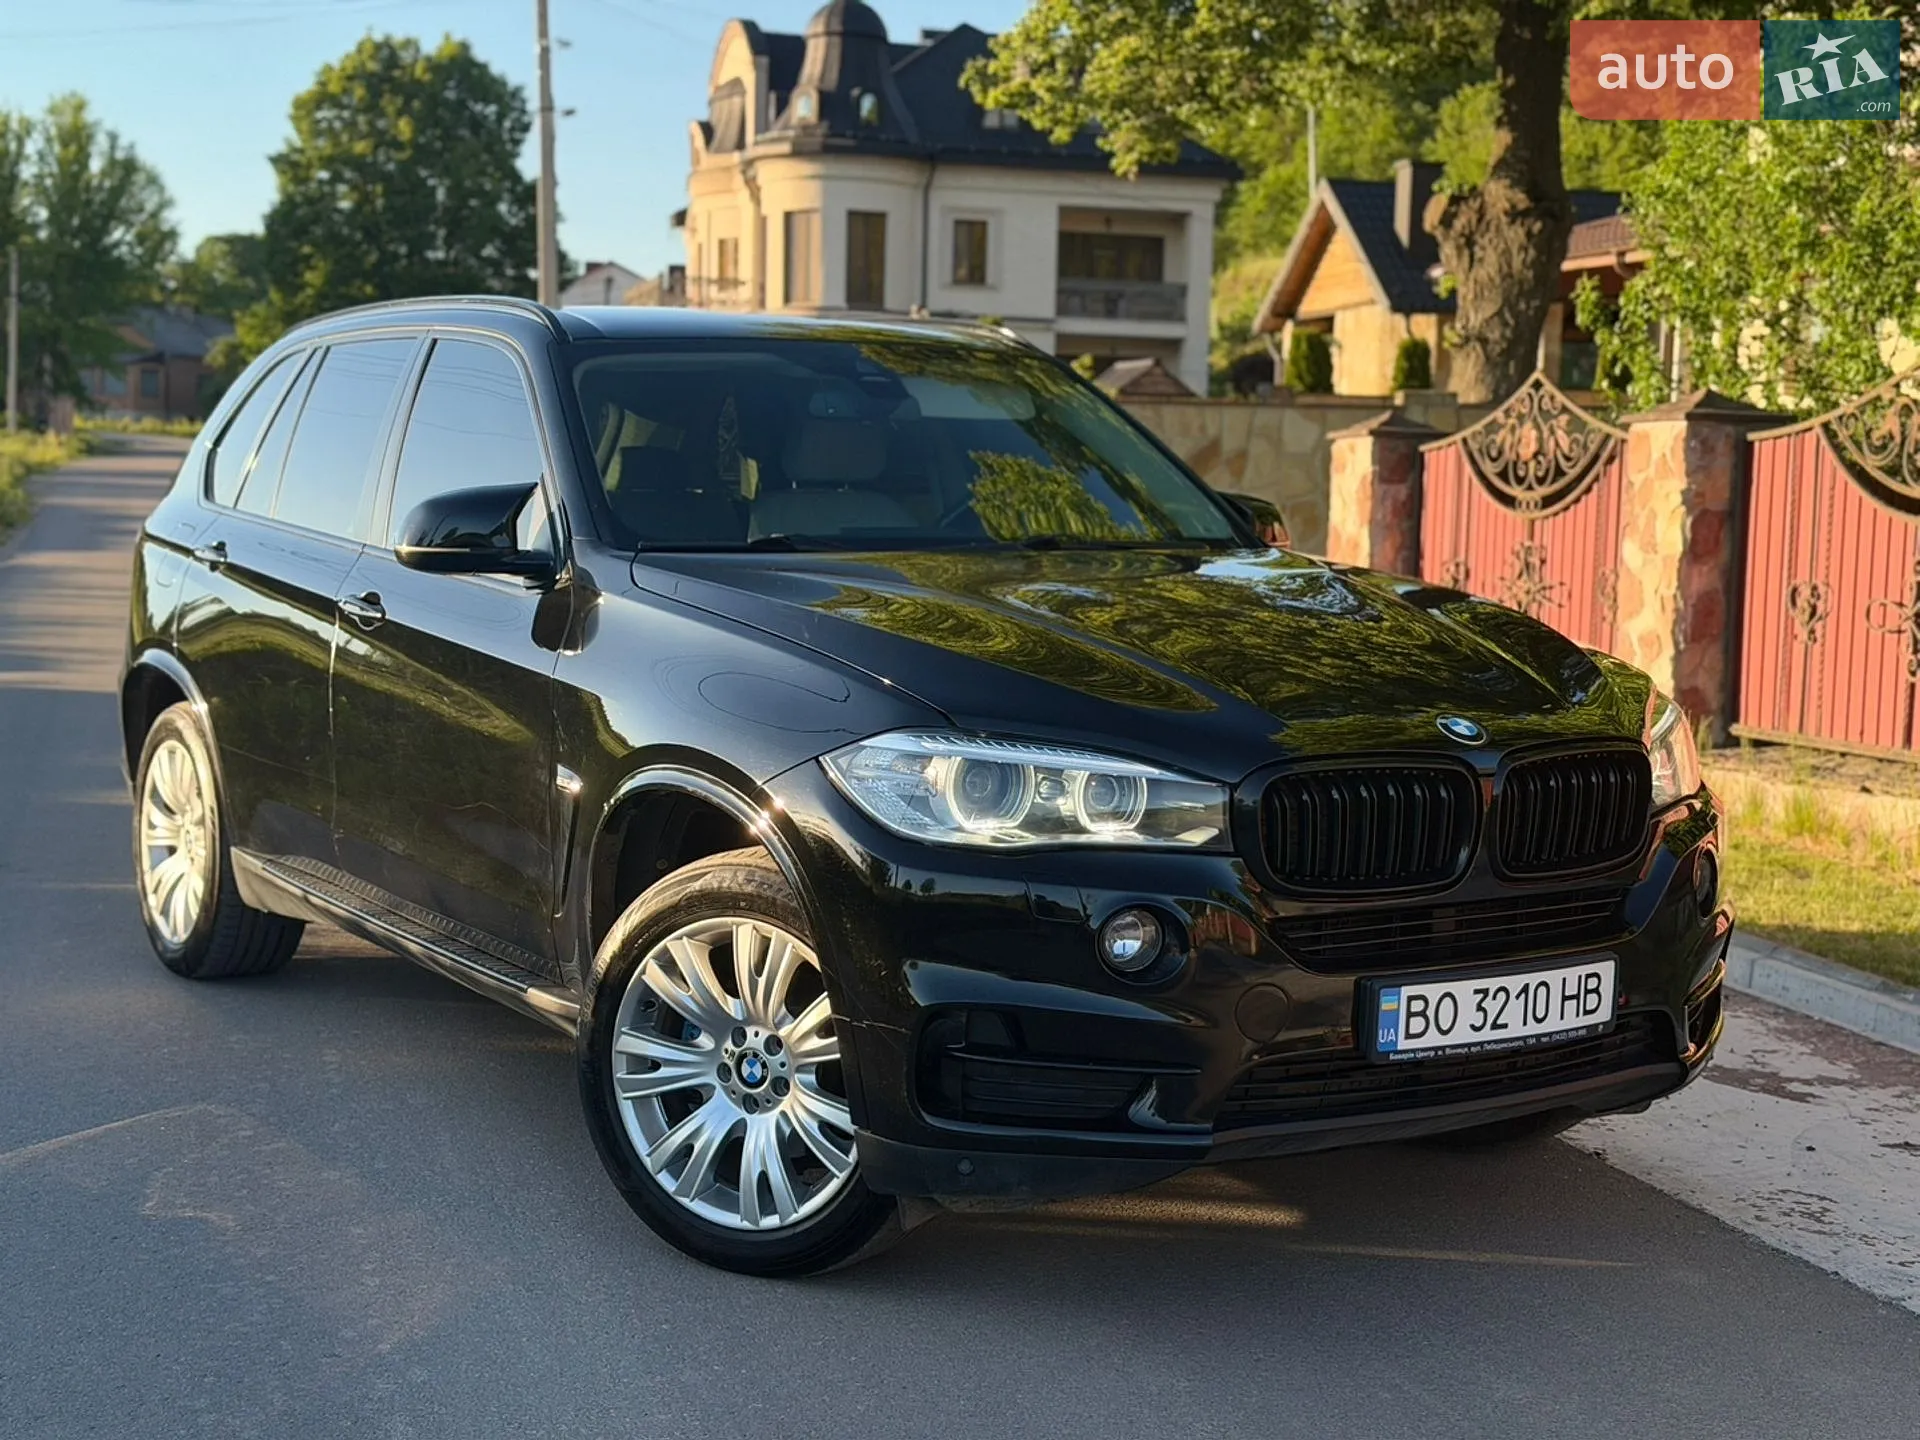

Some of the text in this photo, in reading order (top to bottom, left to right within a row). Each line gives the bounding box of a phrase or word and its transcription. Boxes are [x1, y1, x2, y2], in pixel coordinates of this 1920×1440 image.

[1404, 971, 1602, 1040] BO 3210 HB
[1378, 1028, 1396, 1044] UA
